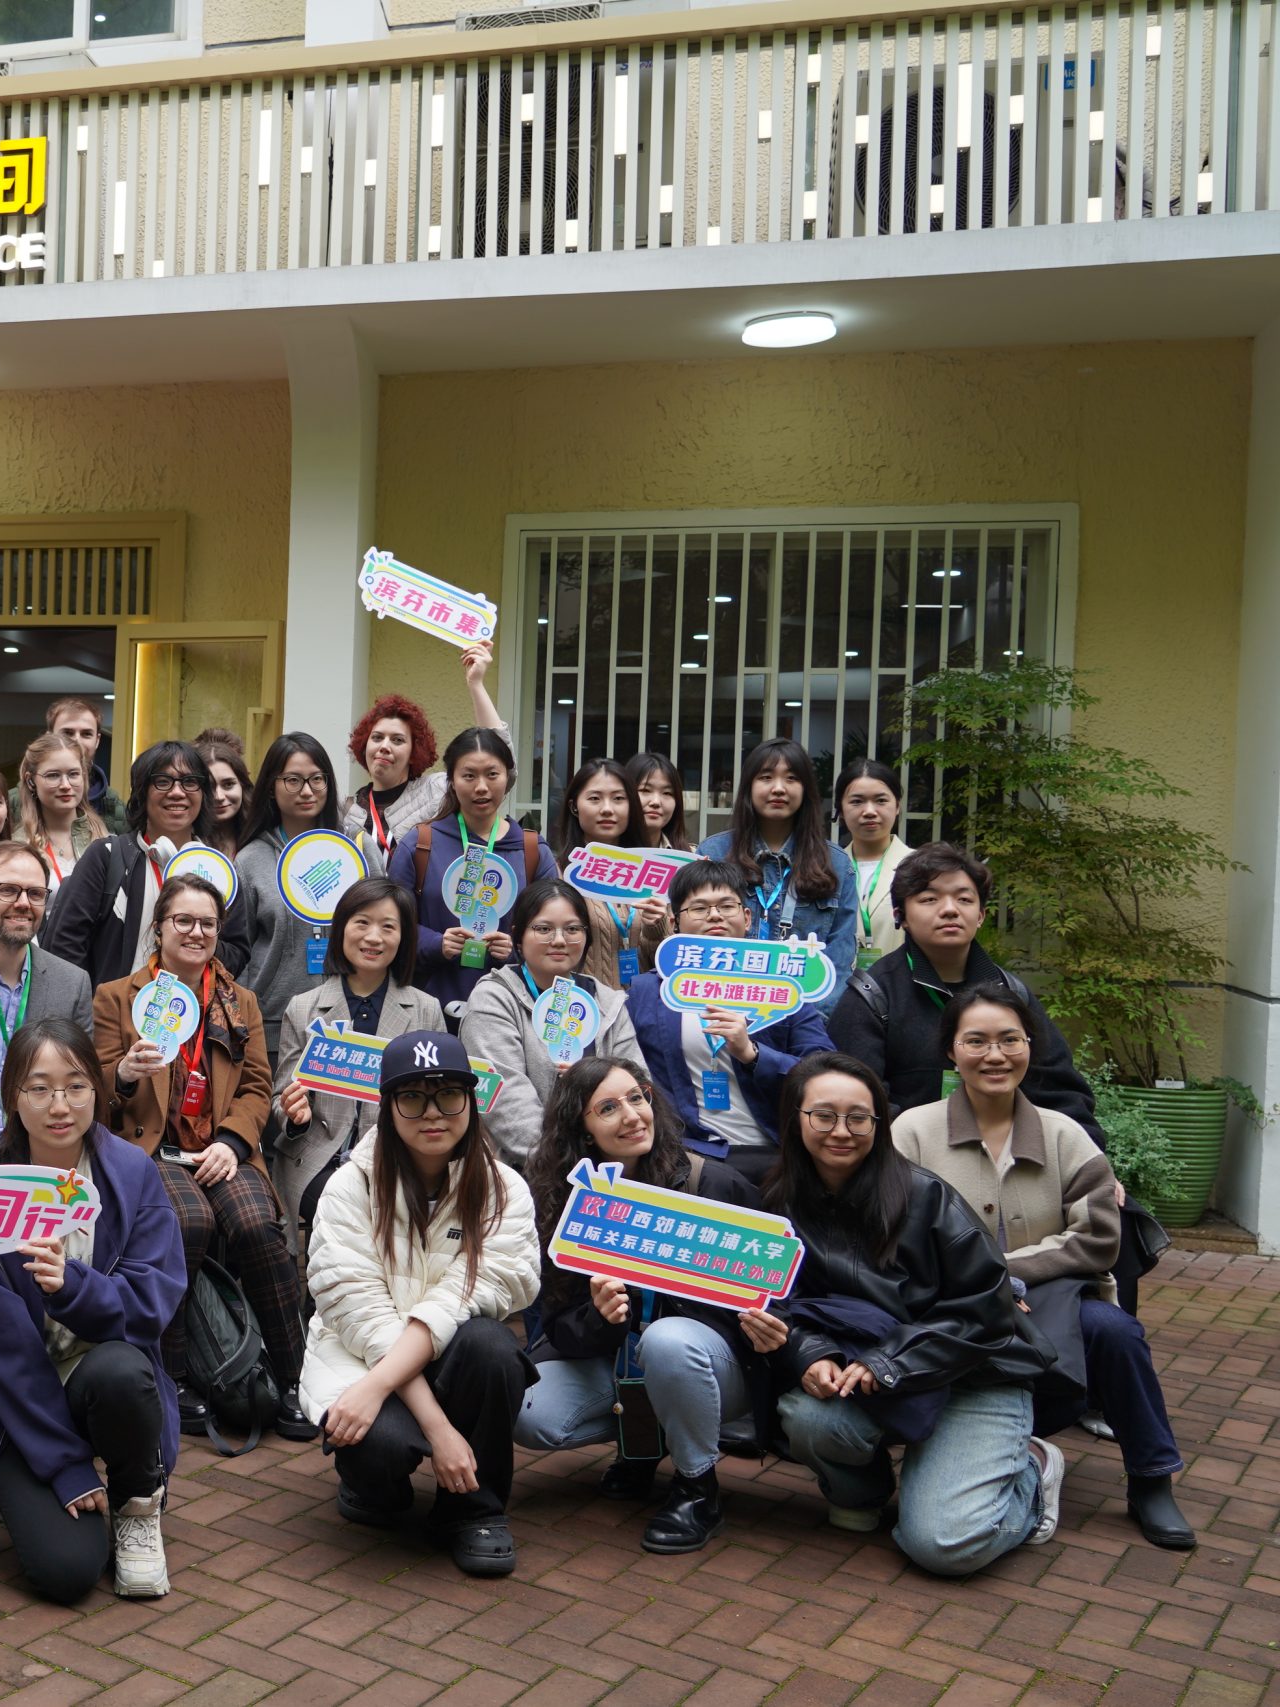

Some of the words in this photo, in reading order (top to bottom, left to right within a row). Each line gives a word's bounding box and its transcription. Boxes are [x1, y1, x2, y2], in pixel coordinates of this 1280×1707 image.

[373, 576, 481, 637] 滨芬市集
[674, 944, 807, 977] 滨芬国际
[680, 979, 791, 1004] 北外滩街道
[308, 1059, 323, 1072] The
[326, 1064, 350, 1077] North
[352, 1069, 374, 1082] Bund
[578, 1194, 786, 1261] 欢迎西郊利物浦大学
[565, 1220, 785, 1286] 国际关系系师生访问北外滩
